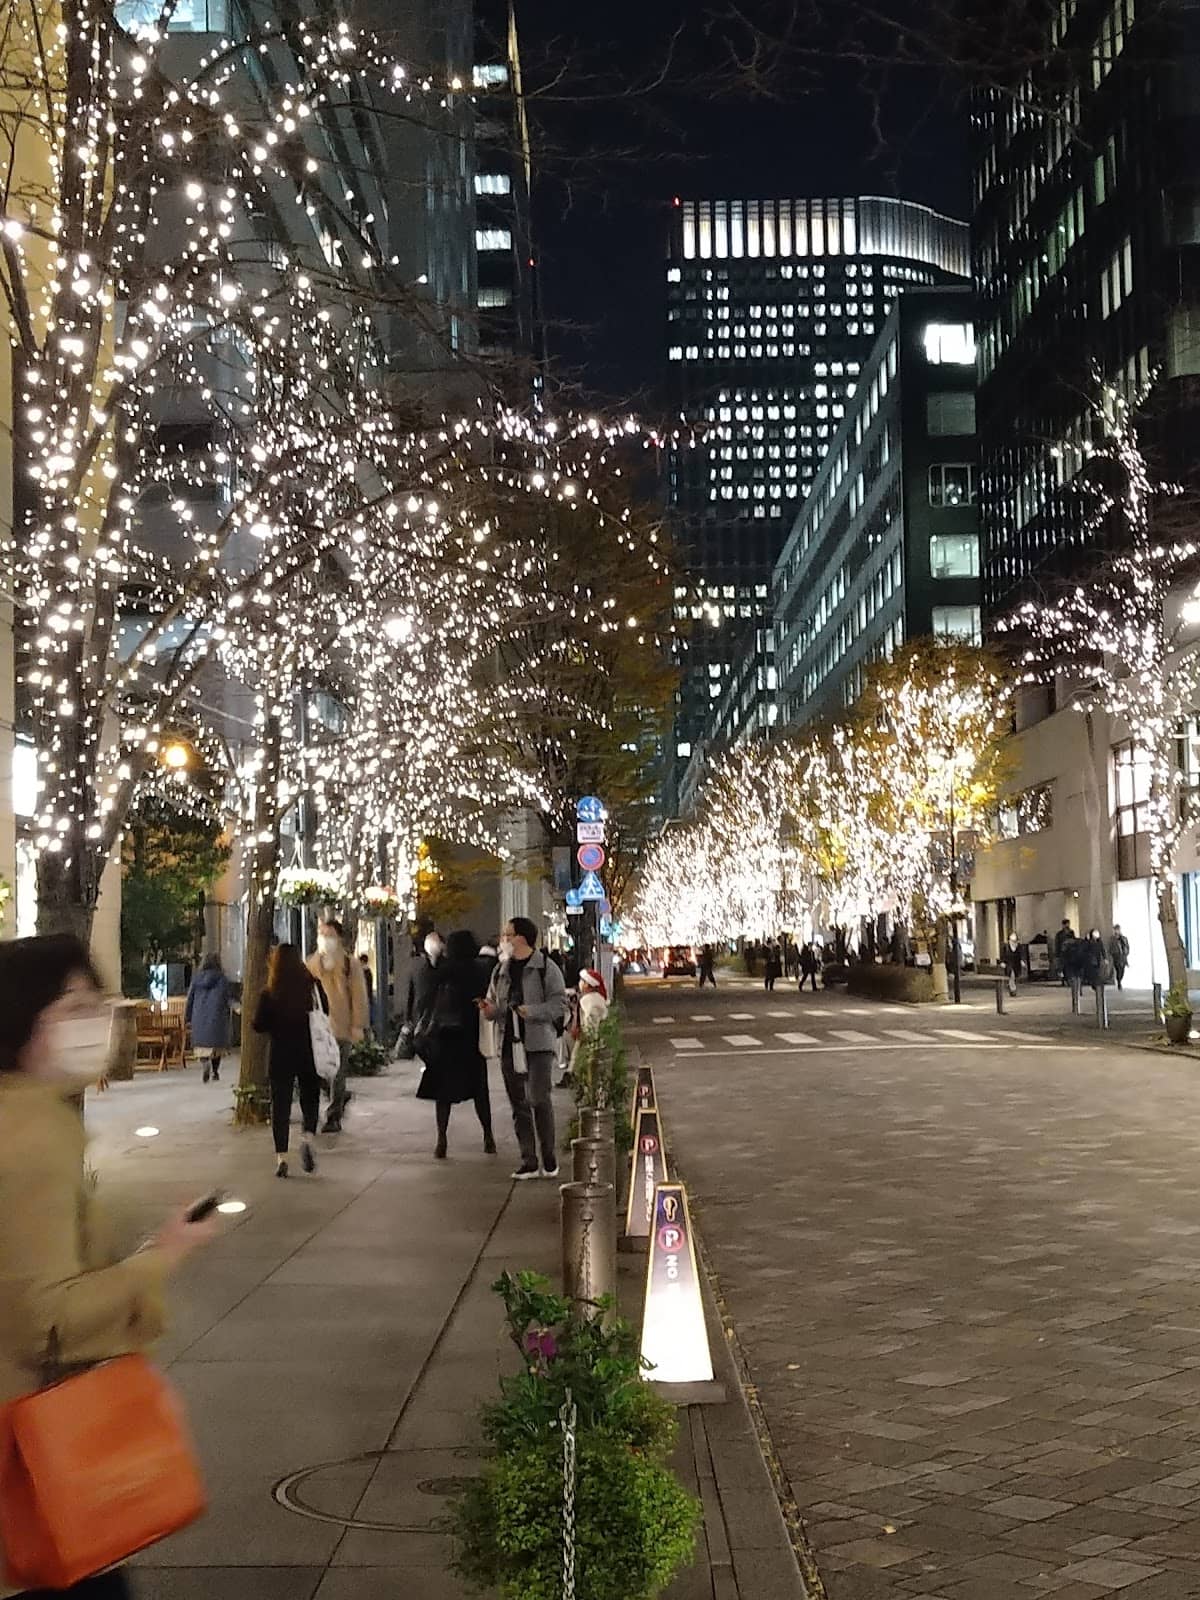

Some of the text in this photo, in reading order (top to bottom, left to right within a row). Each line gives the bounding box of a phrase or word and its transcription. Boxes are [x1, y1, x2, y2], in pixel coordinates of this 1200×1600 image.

[645, 1139, 654, 1152] P
[665, 1229, 679, 1248] P
[665, 1254, 679, 1279] NO
